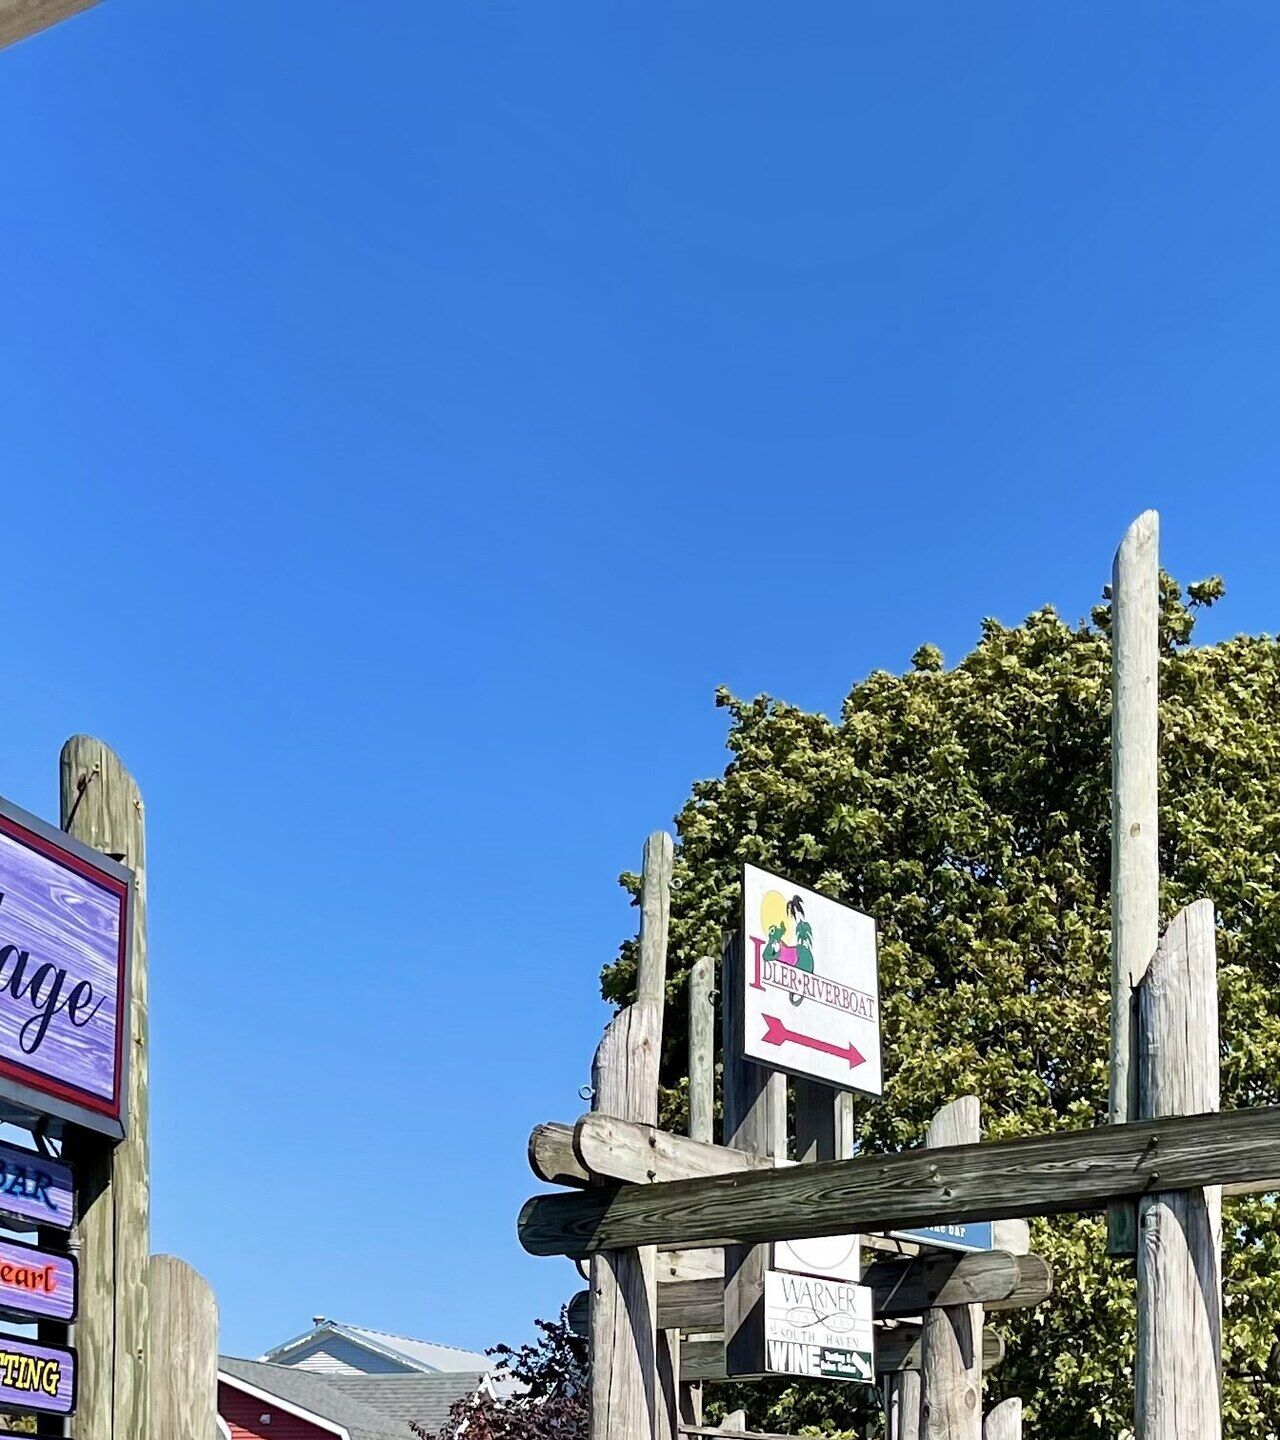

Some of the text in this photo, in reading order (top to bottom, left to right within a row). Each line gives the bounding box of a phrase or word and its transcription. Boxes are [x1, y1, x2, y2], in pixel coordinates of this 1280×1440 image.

[749, 936, 875, 1019] IDLER RIVERBOAT
[782, 1278, 856, 1313] WARNER
[780, 1329, 815, 1342] SOUTH
[827, 1334, 859, 1348] HAVEN
[769, 1341, 821, 1375] WINE
